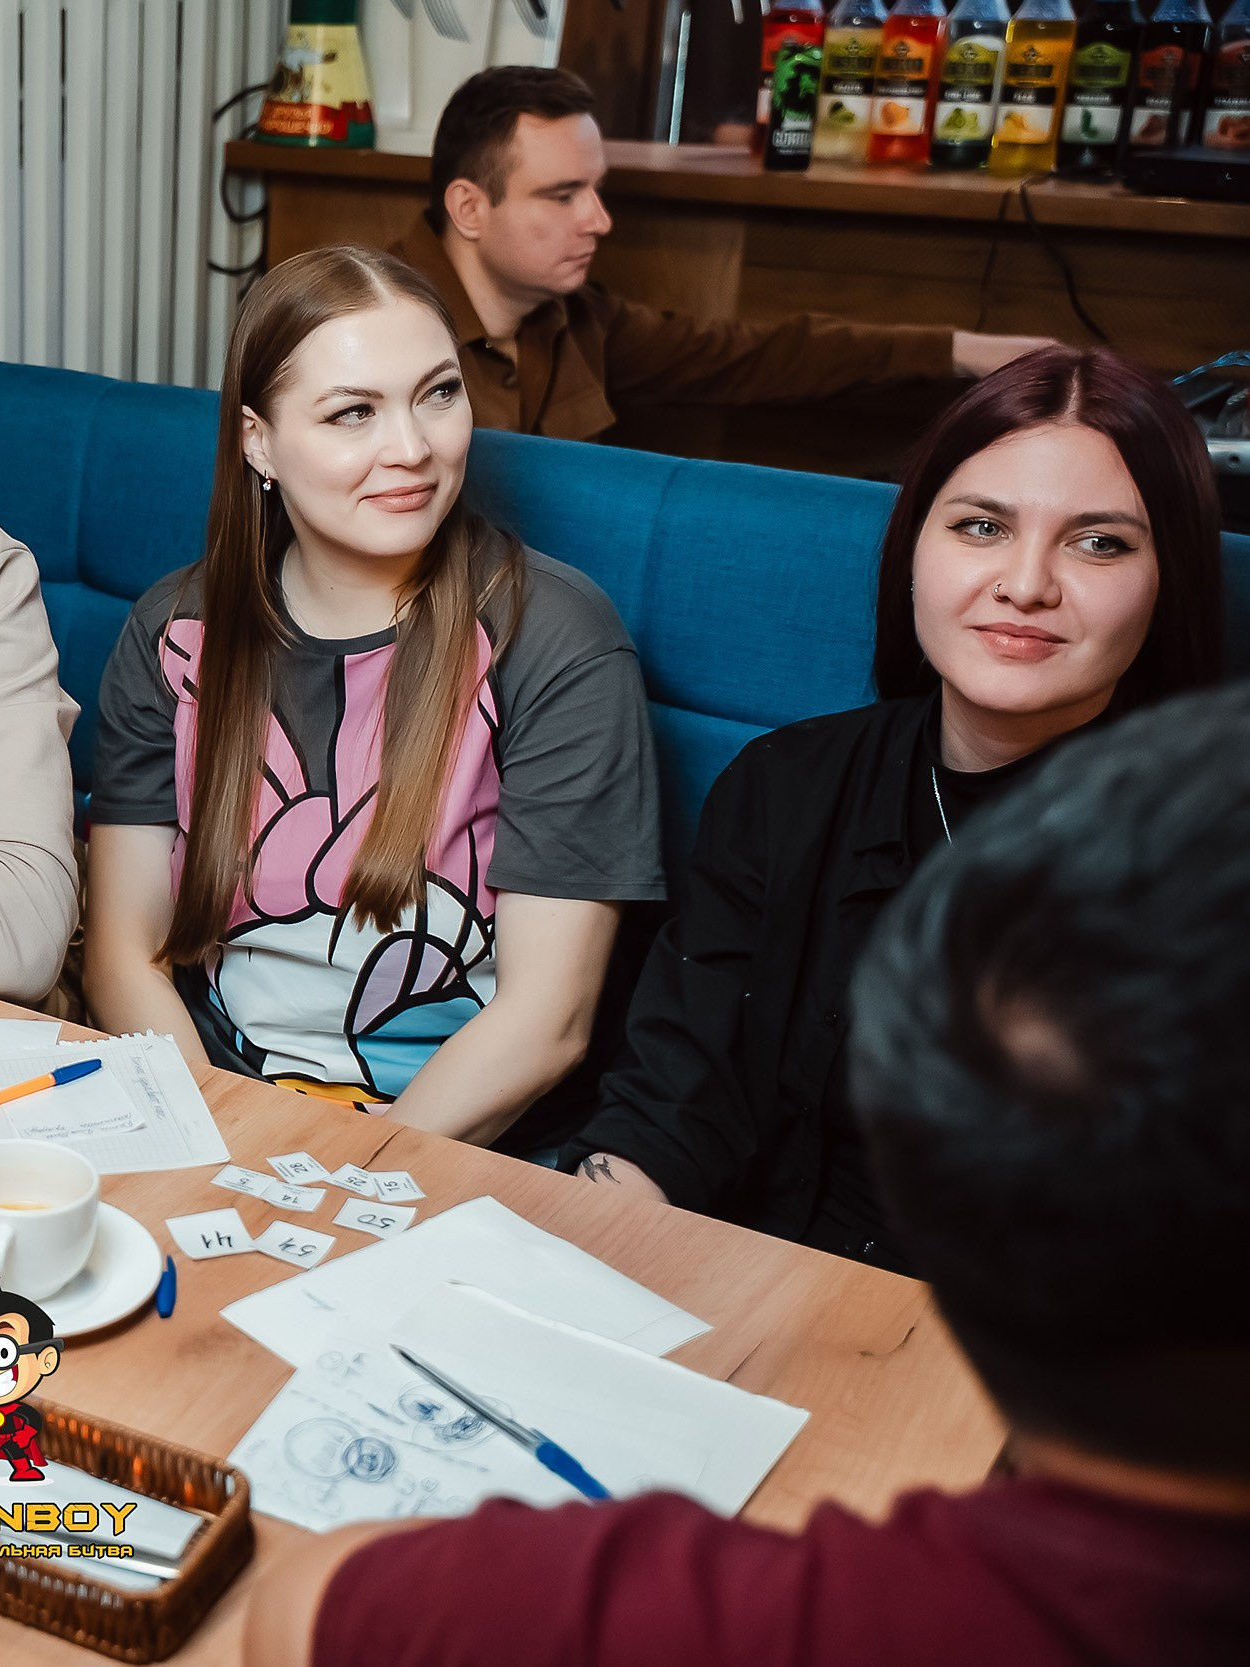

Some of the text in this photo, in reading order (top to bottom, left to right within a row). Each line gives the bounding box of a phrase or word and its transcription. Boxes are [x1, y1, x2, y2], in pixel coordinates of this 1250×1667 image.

[239, 1177, 250, 1185] 5
[346, 1176, 367, 1187] 25
[383, 1181, 400, 1192] 15
[281, 1193, 299, 1204] 14
[357, 1213, 396, 1229] 50
[200, 1230, 233, 1248] 41
